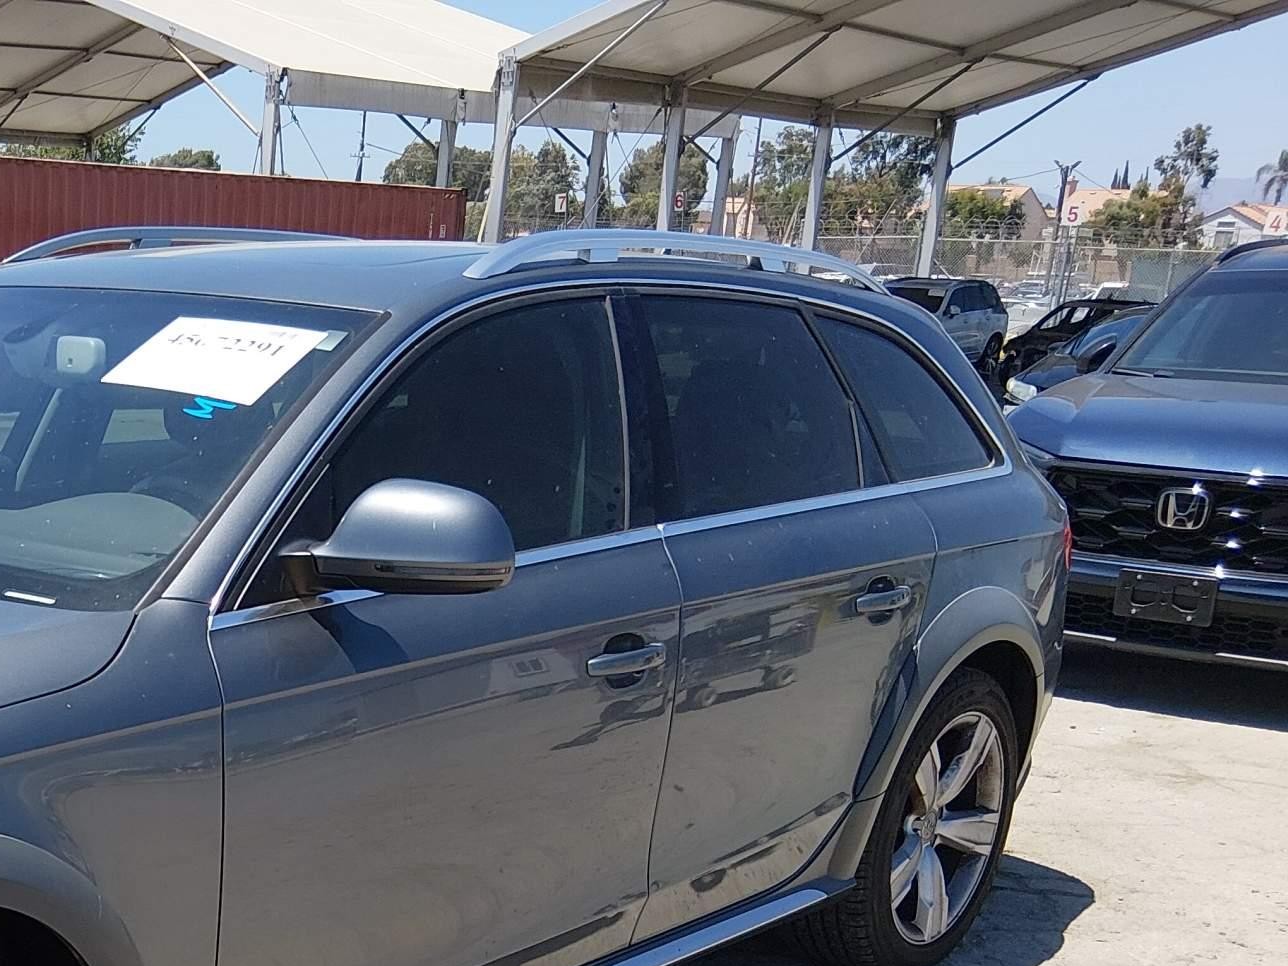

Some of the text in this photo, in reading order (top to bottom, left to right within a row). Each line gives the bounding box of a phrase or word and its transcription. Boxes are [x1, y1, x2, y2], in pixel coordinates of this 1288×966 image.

[558, 196, 567, 210] 7
[675, 194, 684, 208] 6
[1067, 206, 1079, 222] 5
[1269, 215, 1282, 232] 4
